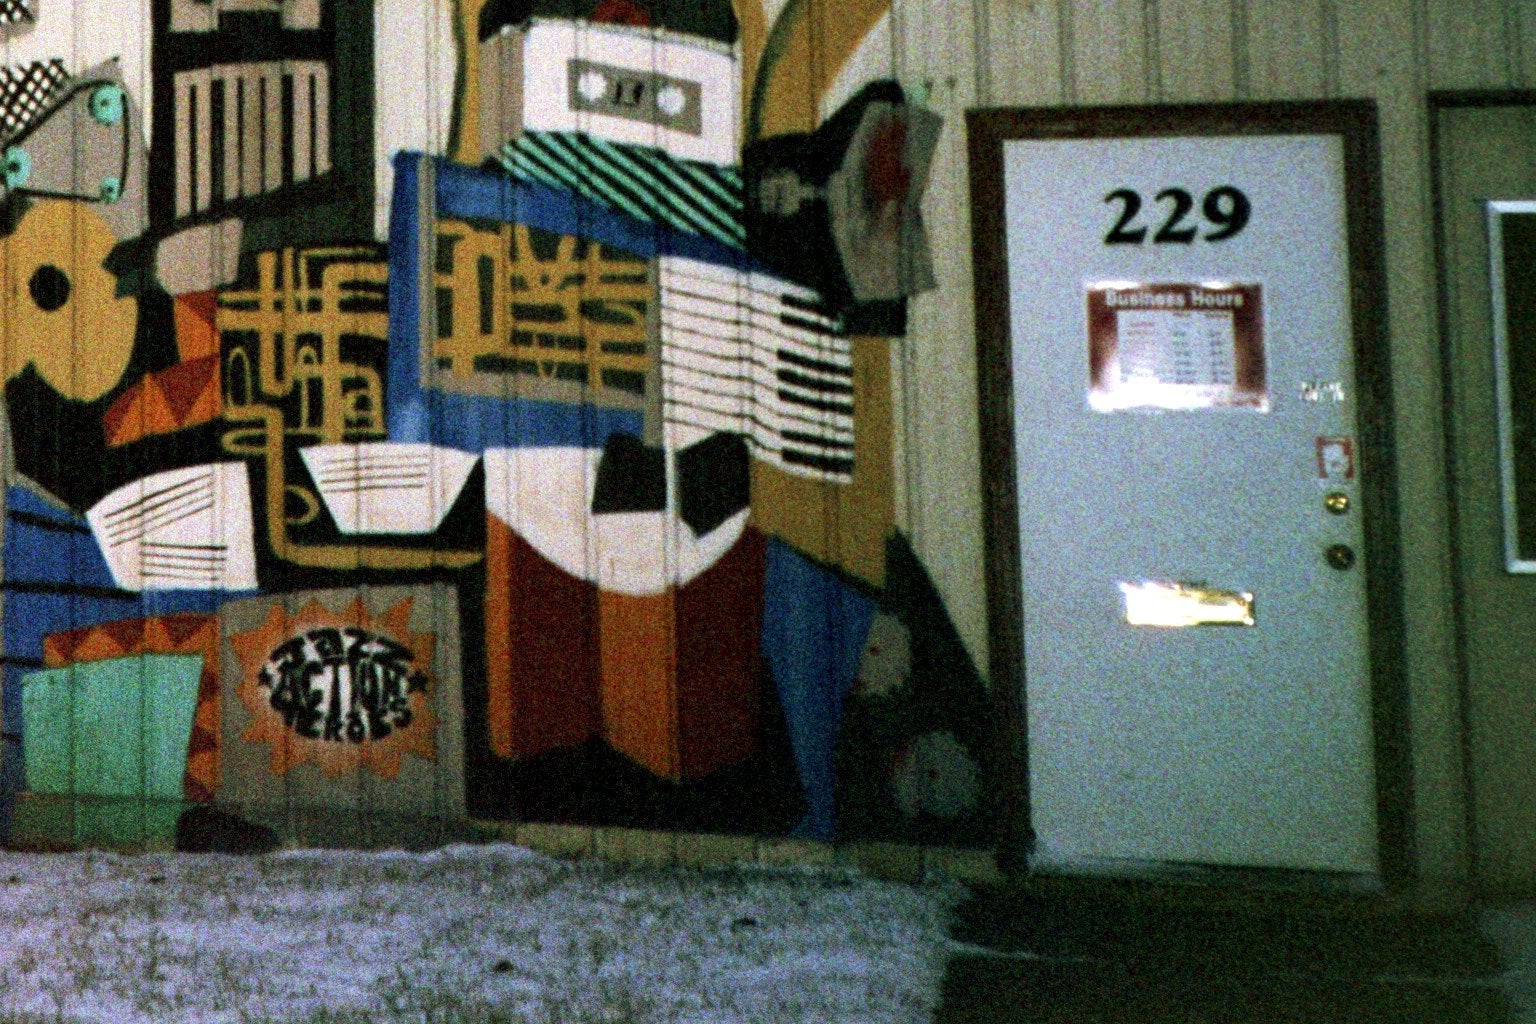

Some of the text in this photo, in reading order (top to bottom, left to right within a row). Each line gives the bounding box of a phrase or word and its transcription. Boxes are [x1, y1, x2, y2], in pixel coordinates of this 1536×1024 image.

[1102, 184, 1252, 245] 229
[1104, 290, 1244, 308] Business Hours
